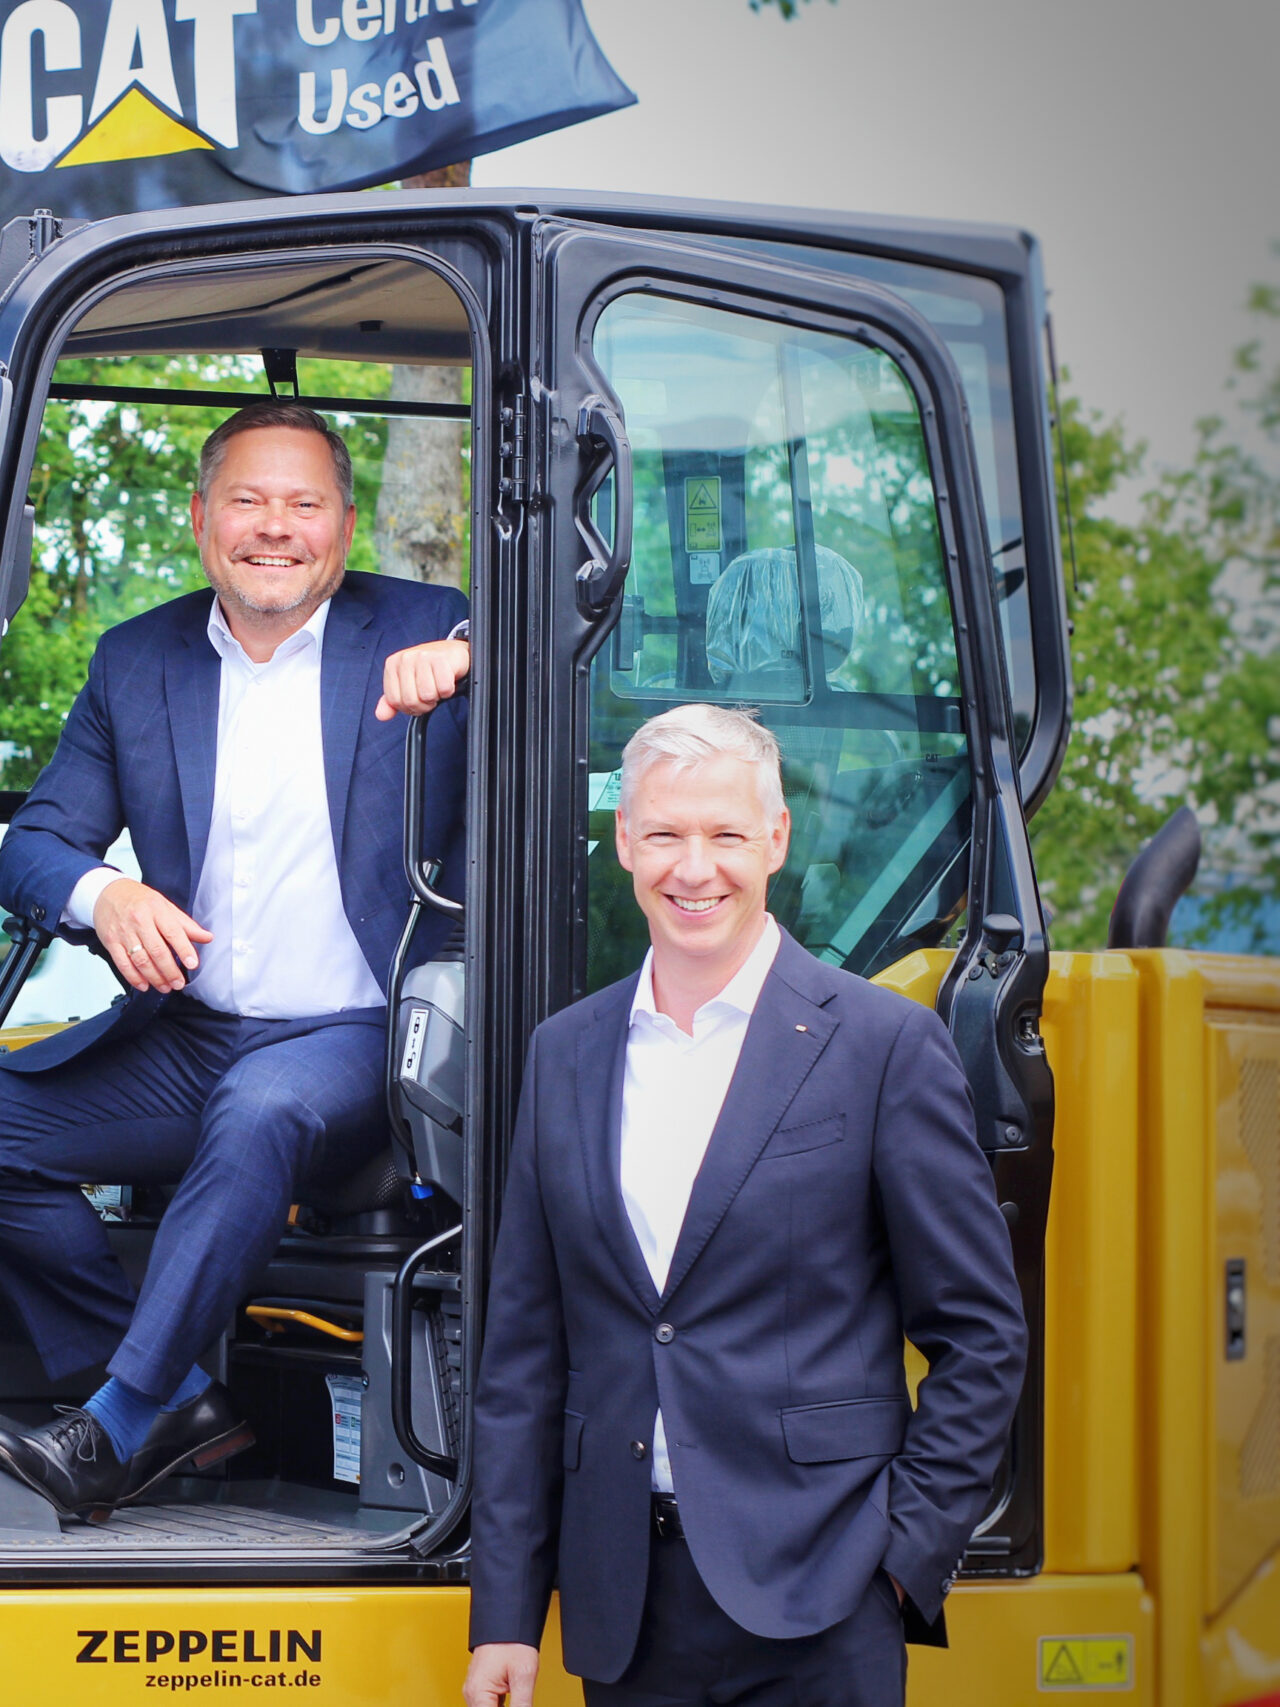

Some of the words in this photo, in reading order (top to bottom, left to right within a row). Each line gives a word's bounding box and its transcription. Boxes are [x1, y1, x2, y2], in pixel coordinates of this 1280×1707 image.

[298, 37, 462, 134] Used
[76, 1630, 322, 1663] ZEPPELIN
[145, 1670, 321, 1691] zeppelin-cat.de
